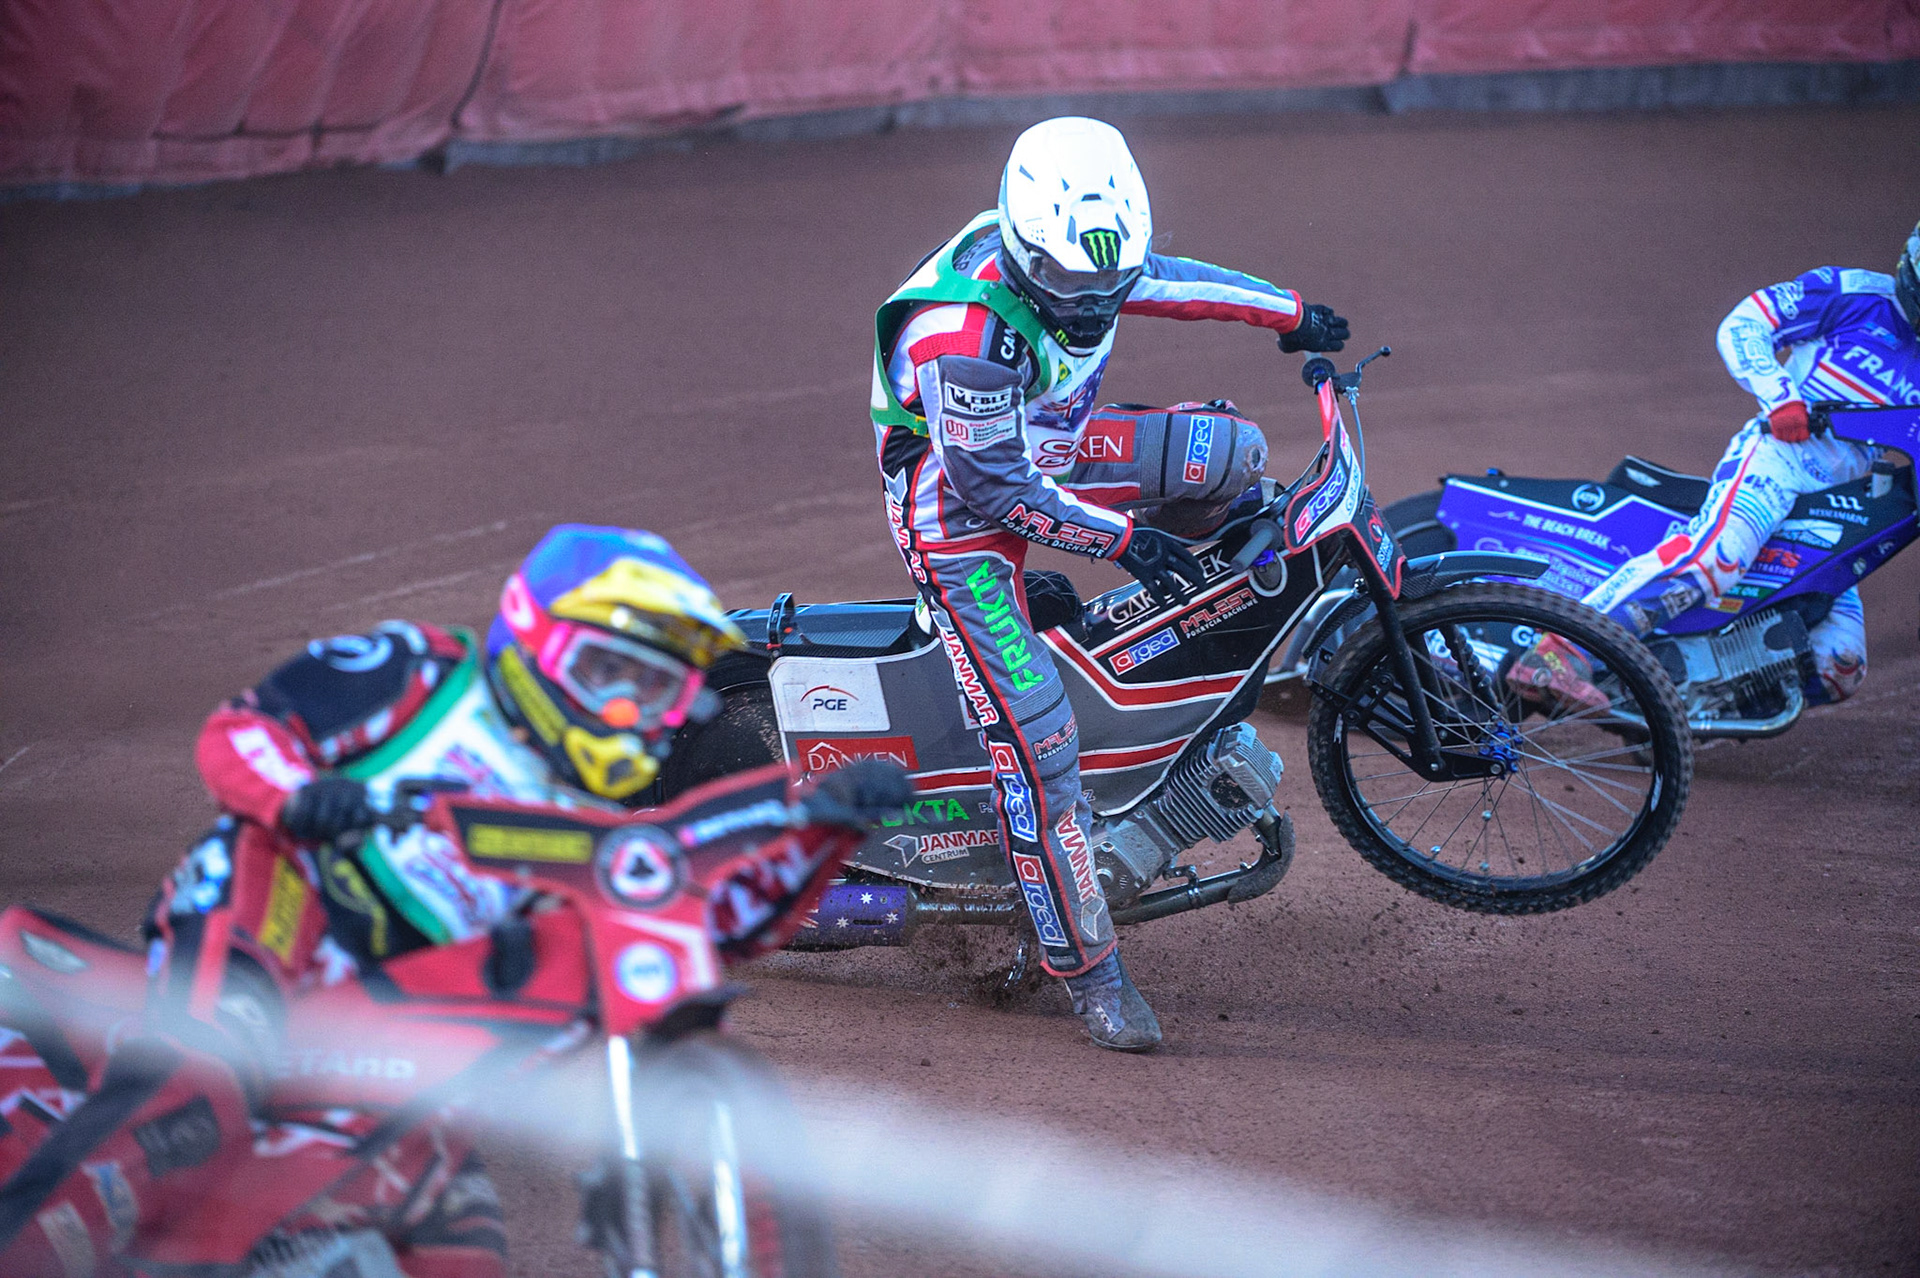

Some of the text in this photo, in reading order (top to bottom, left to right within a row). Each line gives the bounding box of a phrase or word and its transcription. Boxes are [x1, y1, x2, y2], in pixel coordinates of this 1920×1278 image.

[1078, 435, 1123, 458] KEN
[1000, 518, 1105, 558] POKRYCIA DACHOWE
[1007, 503, 1115, 550] MALESA
[966, 560, 1045, 692] FRUKTA
[1179, 587, 1254, 633] MALESA
[1186, 598, 1258, 639] POKRYCIA DACHOWE
[942, 631, 999, 727] JANMAR
[812, 698, 848, 711] PGE
[924, 849, 968, 863] CENTRUM
